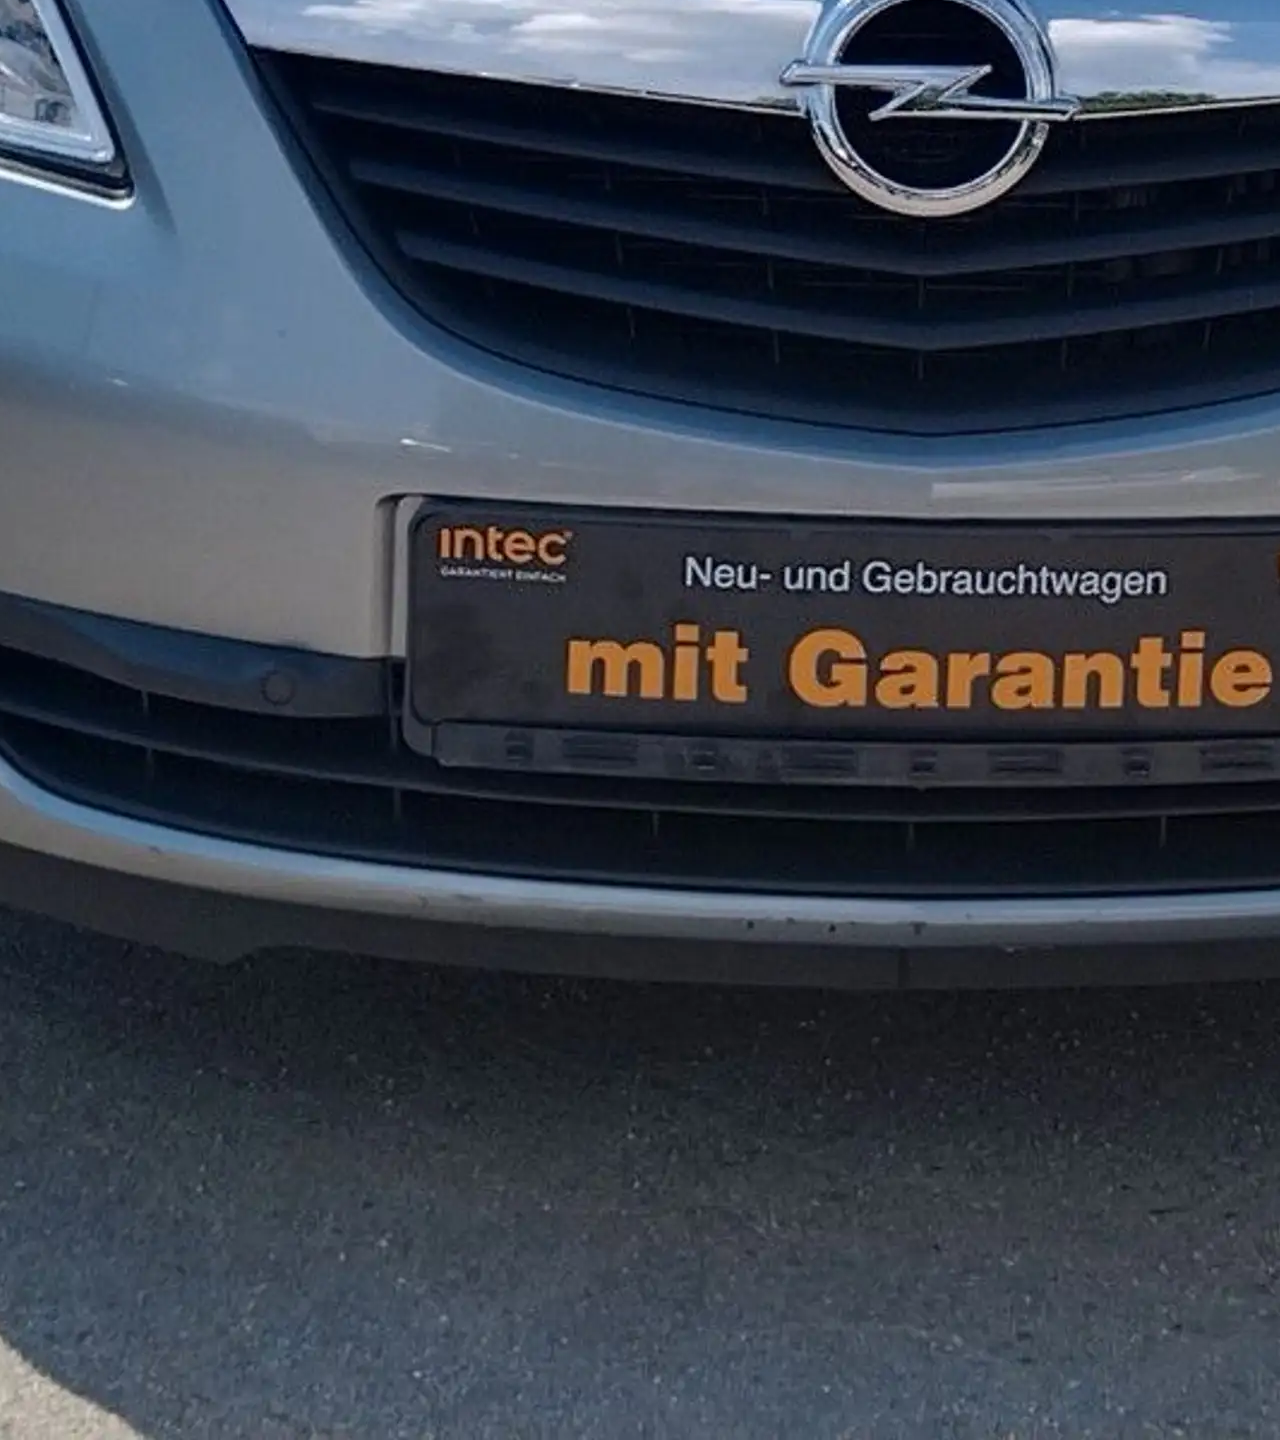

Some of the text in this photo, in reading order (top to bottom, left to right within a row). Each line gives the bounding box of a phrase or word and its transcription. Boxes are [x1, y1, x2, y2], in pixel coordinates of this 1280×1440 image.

[685, 556, 1167, 604] Neu- und Gebrauchtwagen
[568, 623, 1273, 709] mit Garantie
